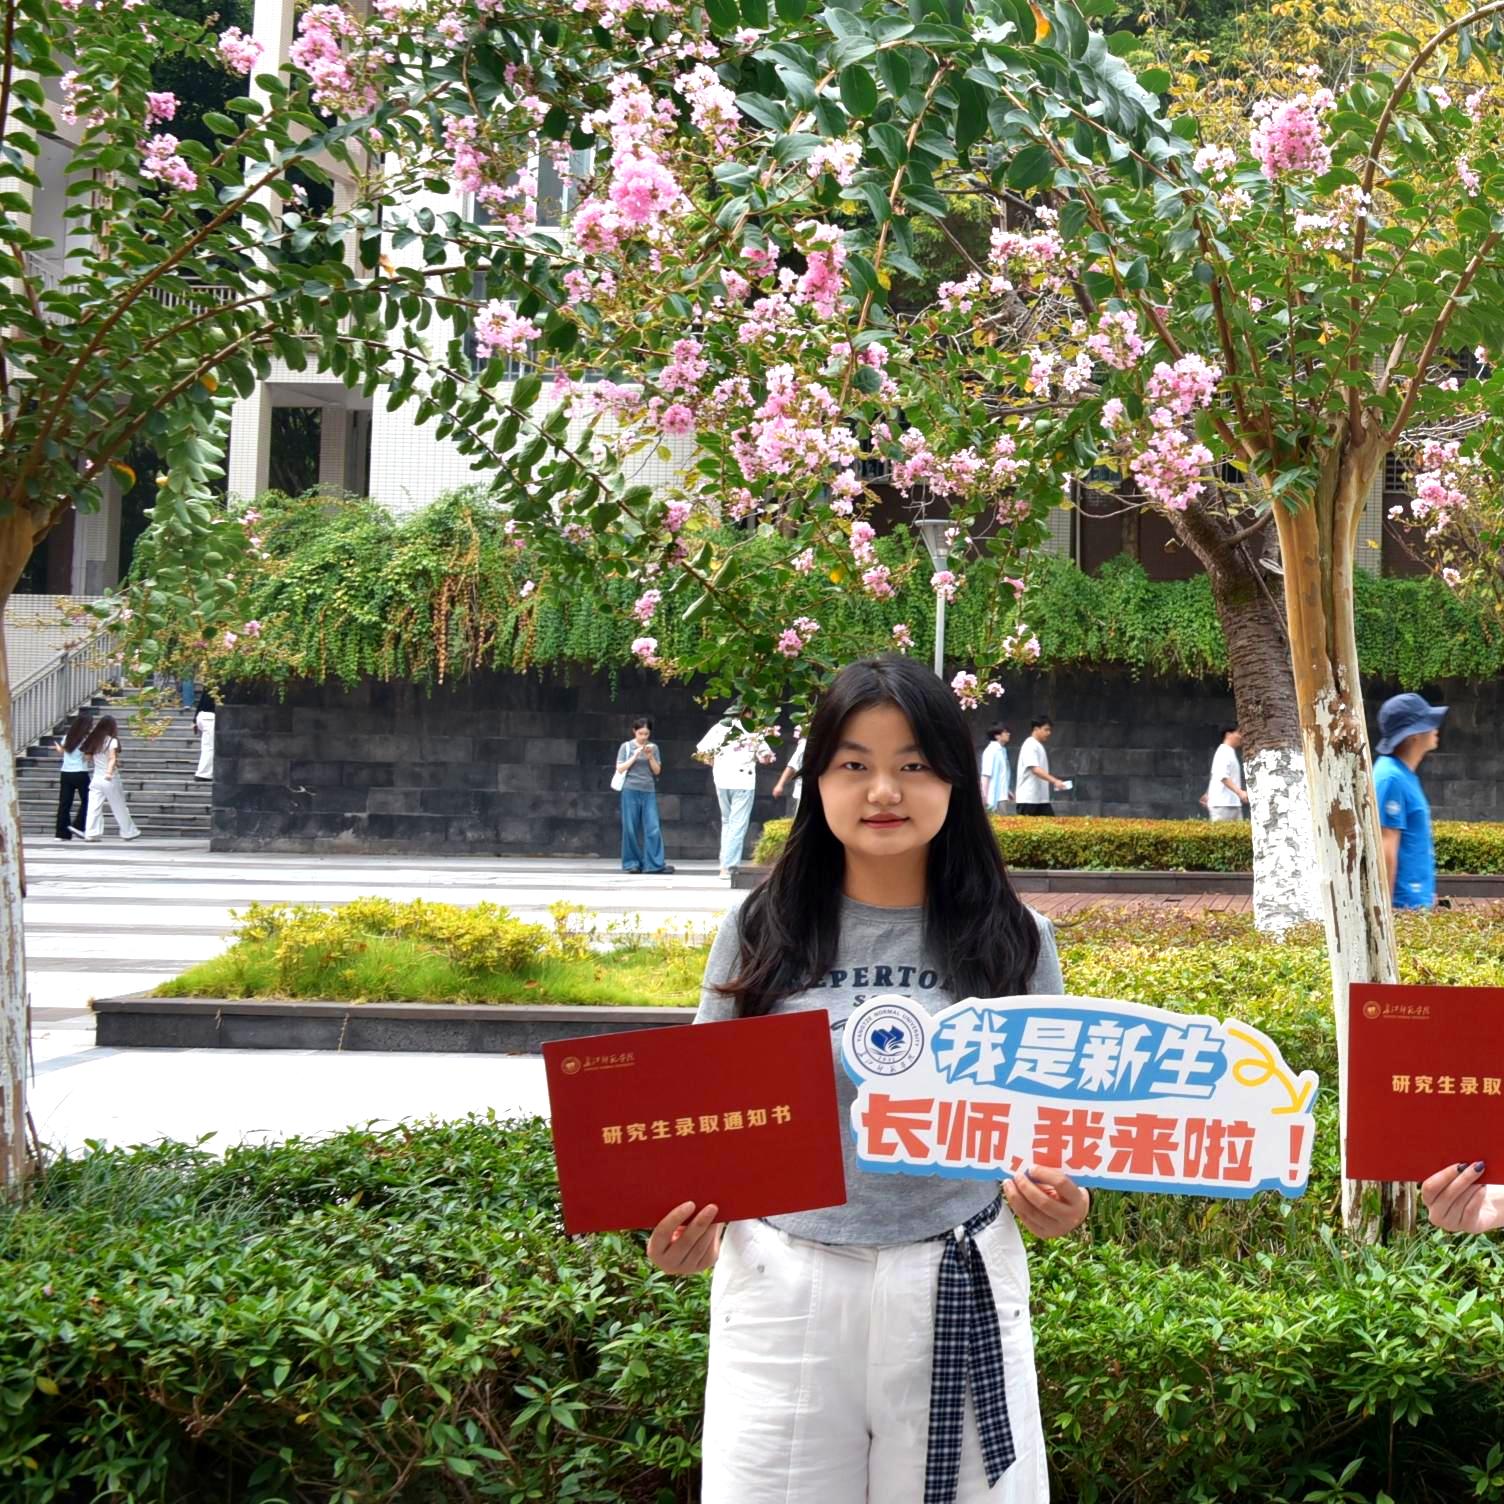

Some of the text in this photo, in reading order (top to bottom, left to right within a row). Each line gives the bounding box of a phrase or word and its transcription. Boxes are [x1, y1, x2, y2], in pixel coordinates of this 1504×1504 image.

[807, 965, 954, 991] PERTO
[873, 1009, 900, 1017] NORMAL
[938, 1009, 1225, 1097] 我是新生
[602, 1104, 792, 1145] 研究生录取通知书
